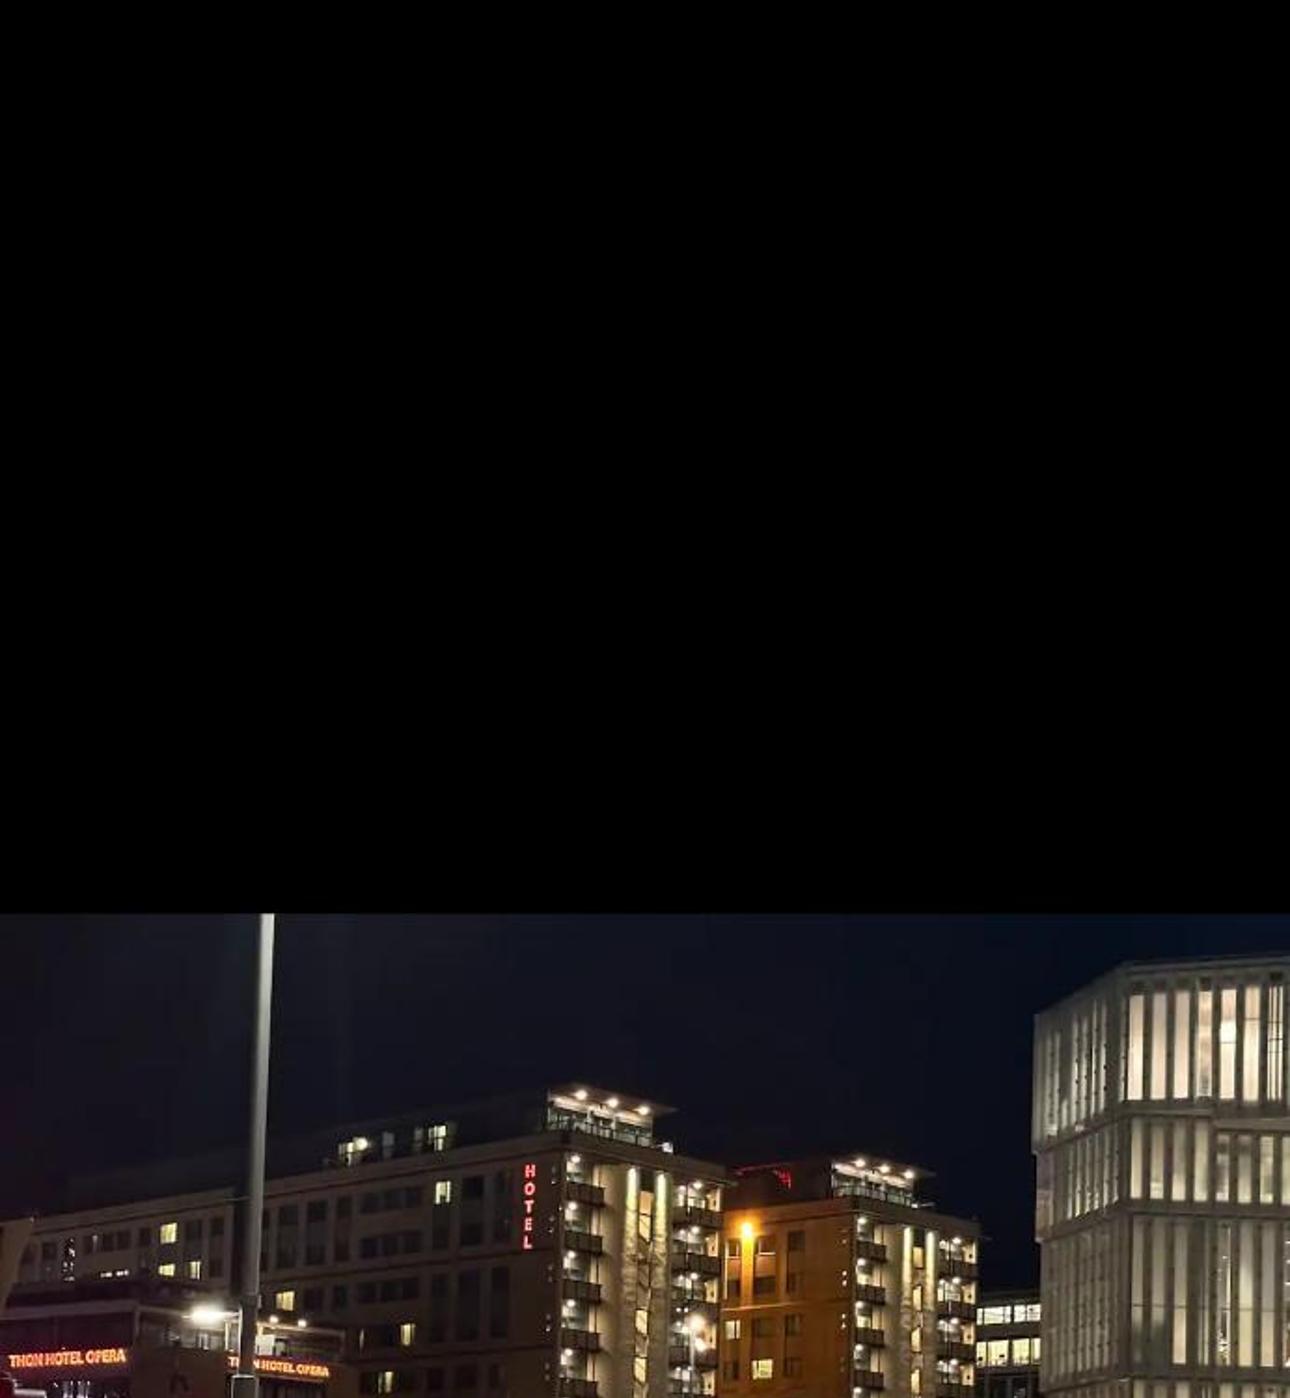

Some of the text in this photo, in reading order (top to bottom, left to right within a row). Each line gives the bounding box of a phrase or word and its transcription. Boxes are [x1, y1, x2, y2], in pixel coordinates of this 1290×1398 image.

[524, 1164, 536, 1249] HOTEL
[9, 1348, 126, 1368] THON HOTEL OPERA
[228, 1356, 329, 1377] TN HOTEL OPERA
